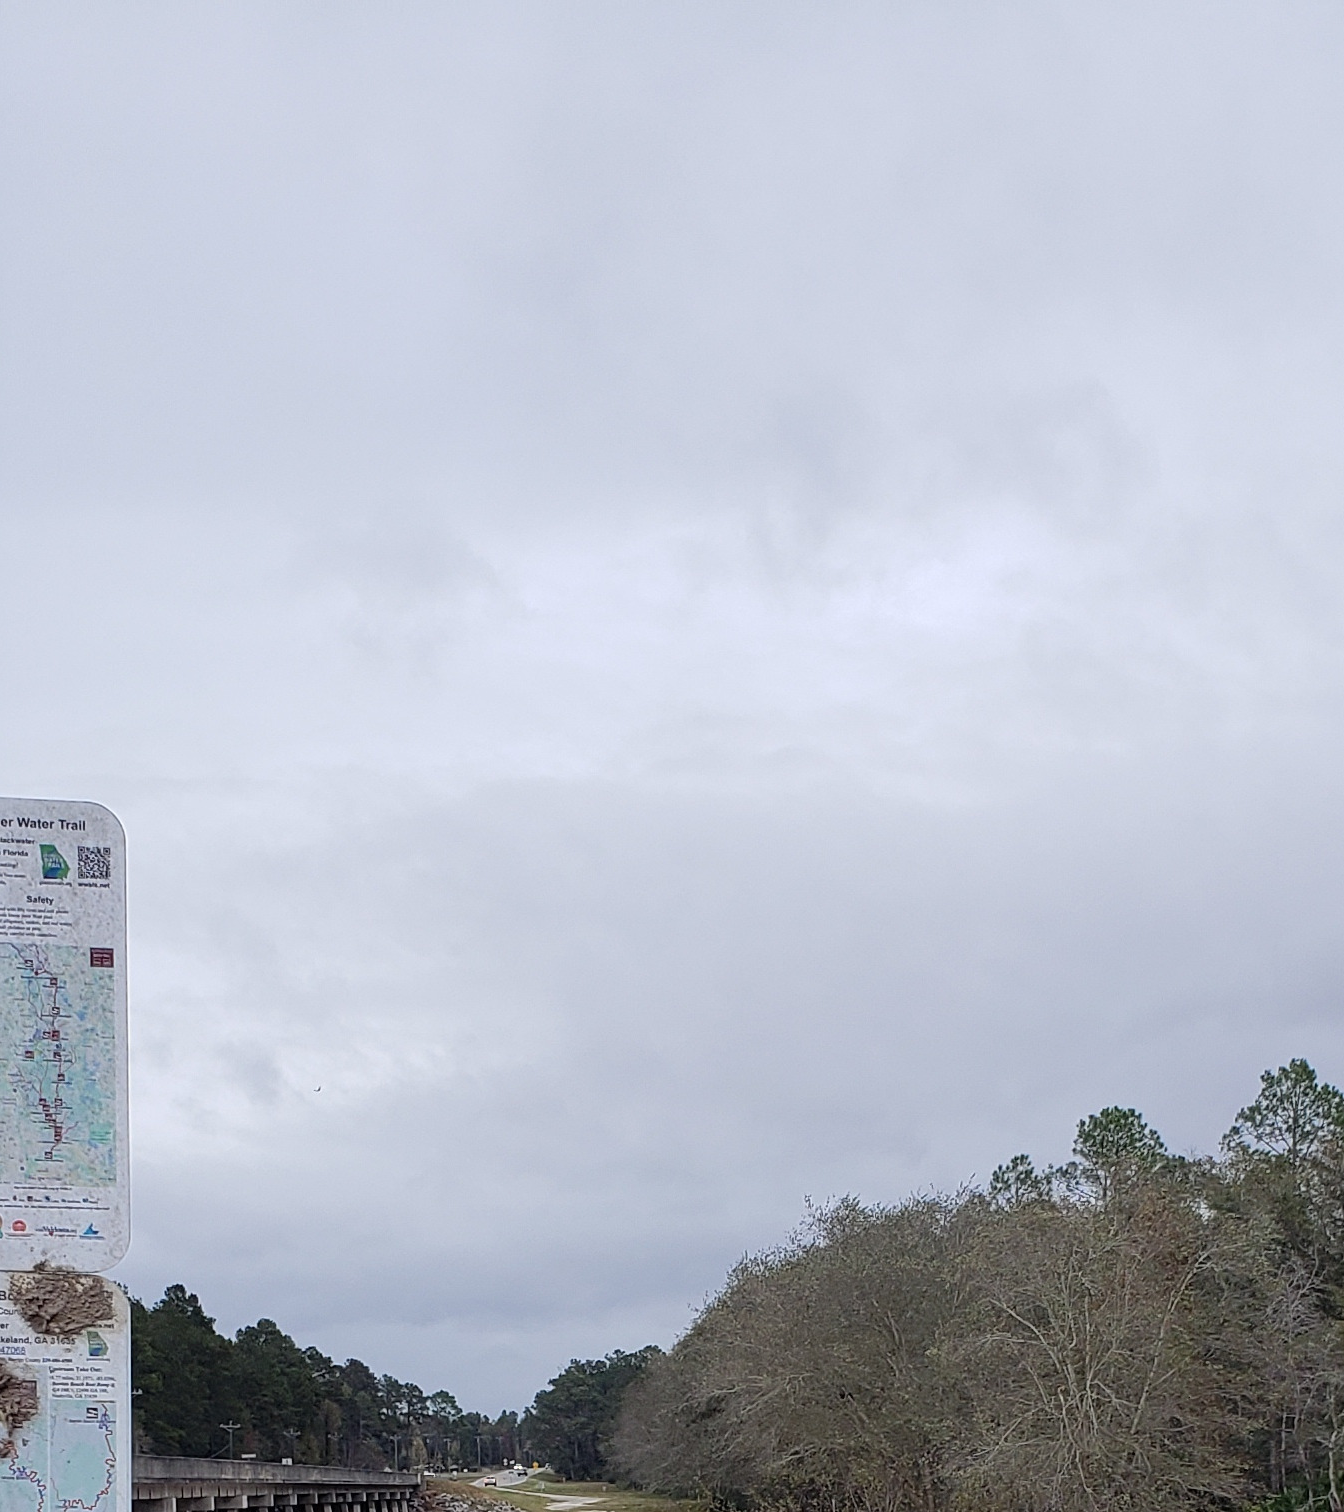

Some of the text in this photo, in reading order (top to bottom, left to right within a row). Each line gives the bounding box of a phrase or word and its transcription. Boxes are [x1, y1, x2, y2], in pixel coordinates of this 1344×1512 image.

[17, 817, 55, 829] Water
[58, 820, 86, 831] Trail
[3, 849, 29, 857] Florida
[26, 895, 54, 906] Safety
[34, 1336, 48, 1345] GA
[50, 1337, 77, 1346] 31635
